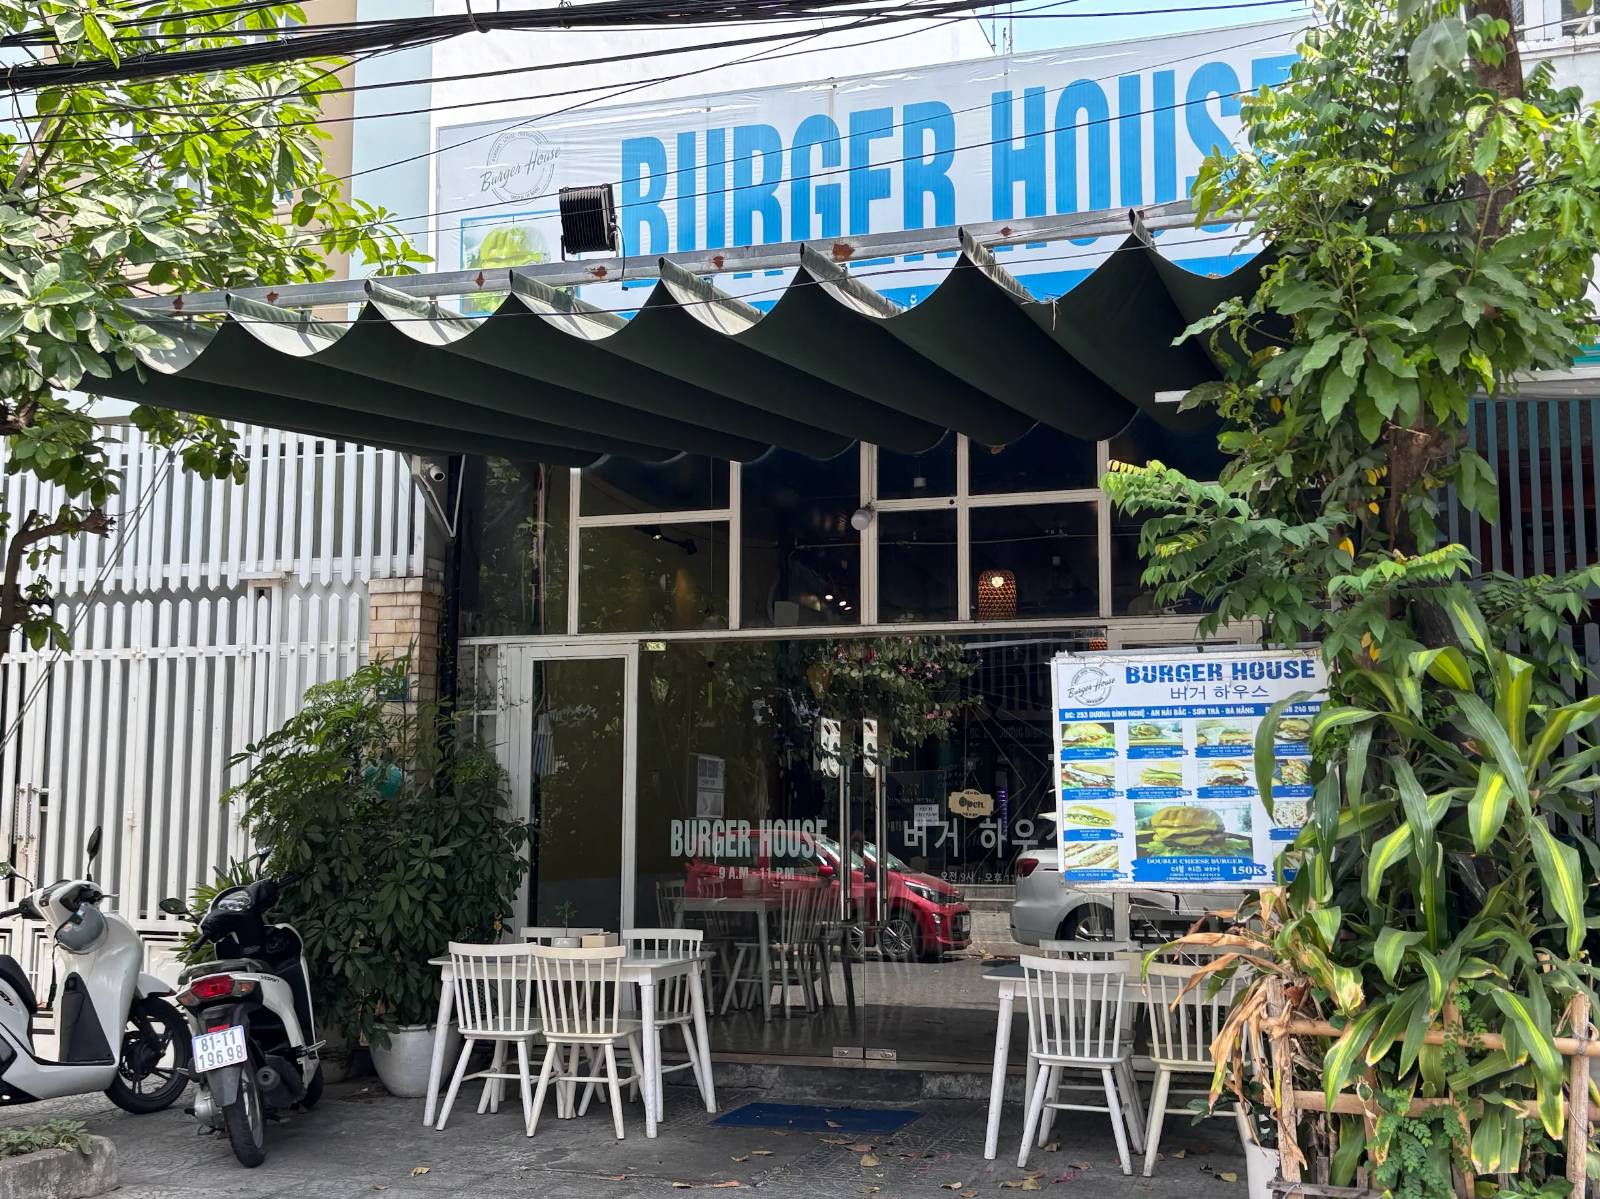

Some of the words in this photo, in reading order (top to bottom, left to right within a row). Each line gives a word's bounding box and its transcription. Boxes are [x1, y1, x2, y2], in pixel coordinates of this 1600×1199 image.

[480, 164, 520, 192] Burger
[524, 147, 561, 175] House
[621, 100, 957, 290] BURGER
[991, 53, 1303, 250] HOUS
[1126, 663, 1222, 684] BURGER
[1232, 659, 1316, 681] HOUSE
[1170, 685, 1206, 700] 버거
[1213, 684, 1269, 700] 하우스
[670, 819, 750, 858] BURGER
[759, 818, 828, 858] HOUSE
[903, 817, 958, 858] 버거
[718, 866, 726, 880] 9
[941, 871, 957, 882] 오전
[1231, 865, 1266, 875] 150K
[200, 1030, 236, 1052] 81-T1
[199, 1045, 244, 1069] 196.98
